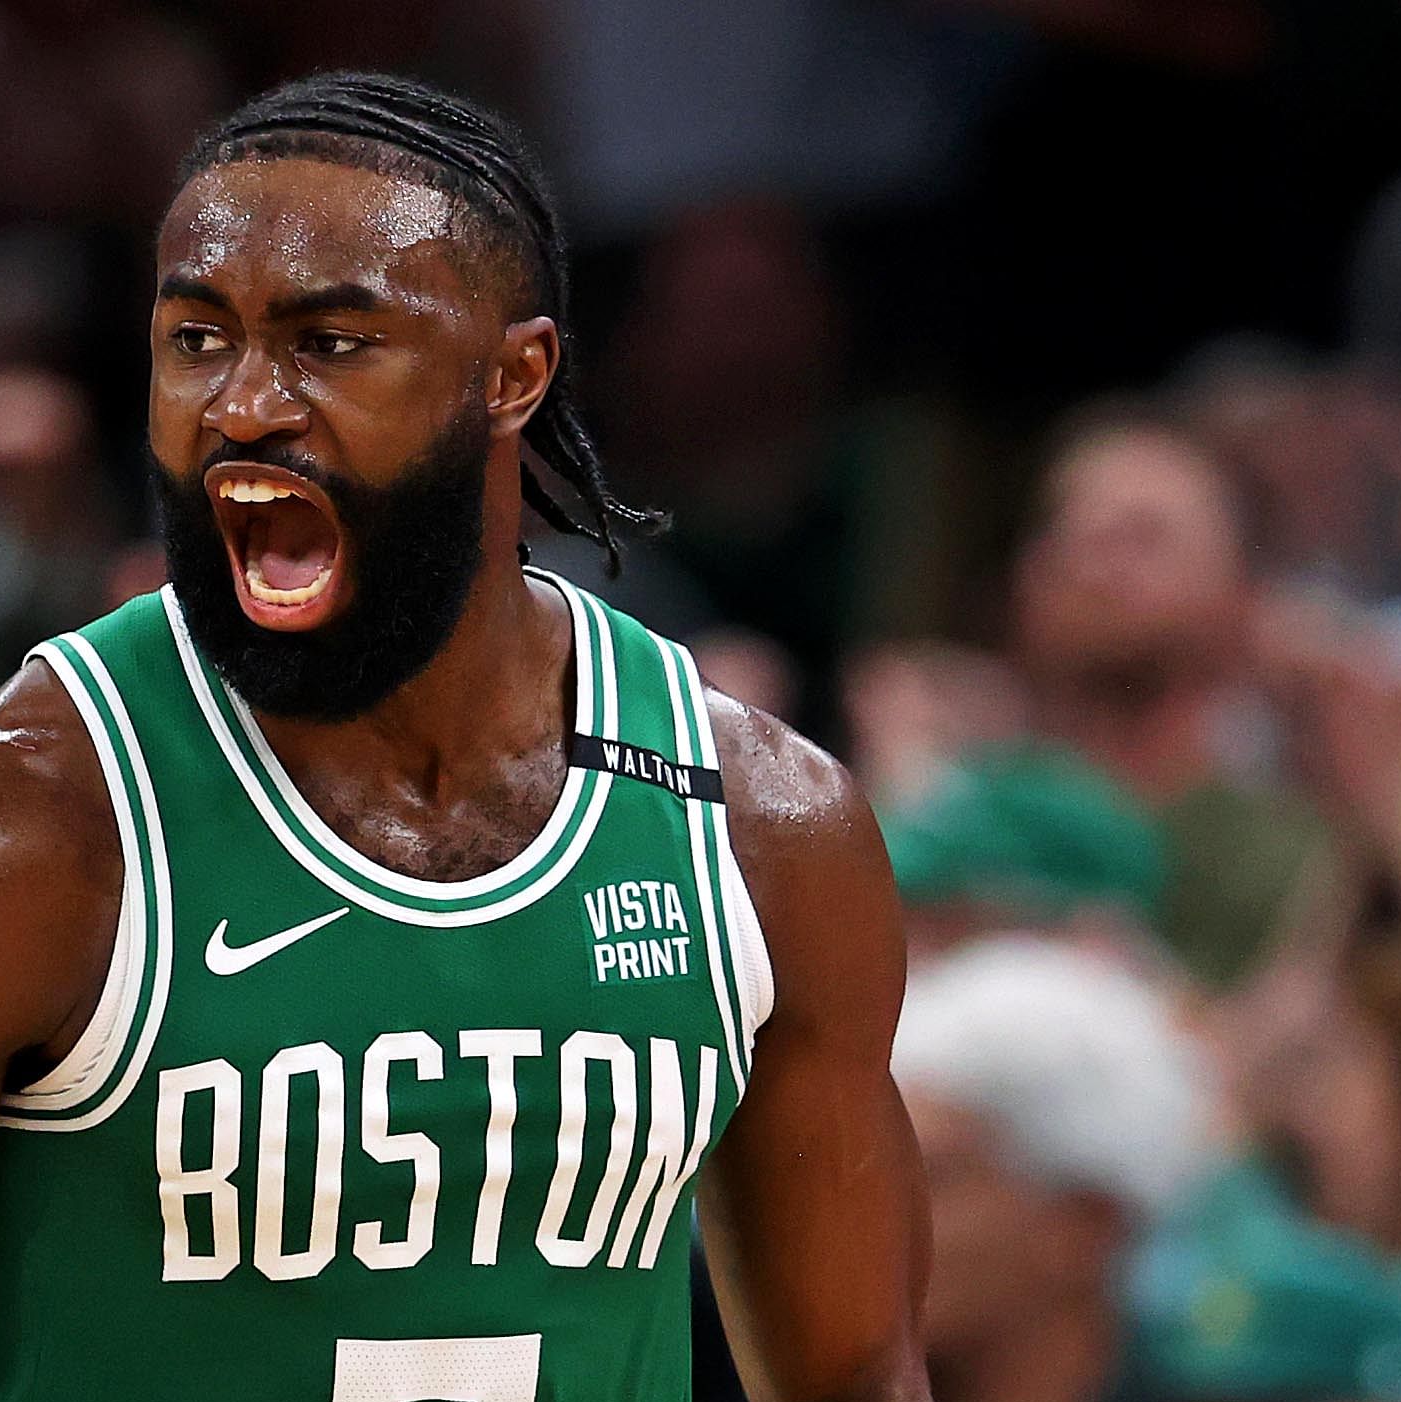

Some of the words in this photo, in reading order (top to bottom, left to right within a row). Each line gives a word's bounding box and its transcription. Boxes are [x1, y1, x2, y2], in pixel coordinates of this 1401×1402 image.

[602, 743, 692, 795] WALTON
[584, 881, 689, 940] VISTA
[594, 937, 690, 982] PRINT
[156, 1029, 719, 1282] BOSTON
